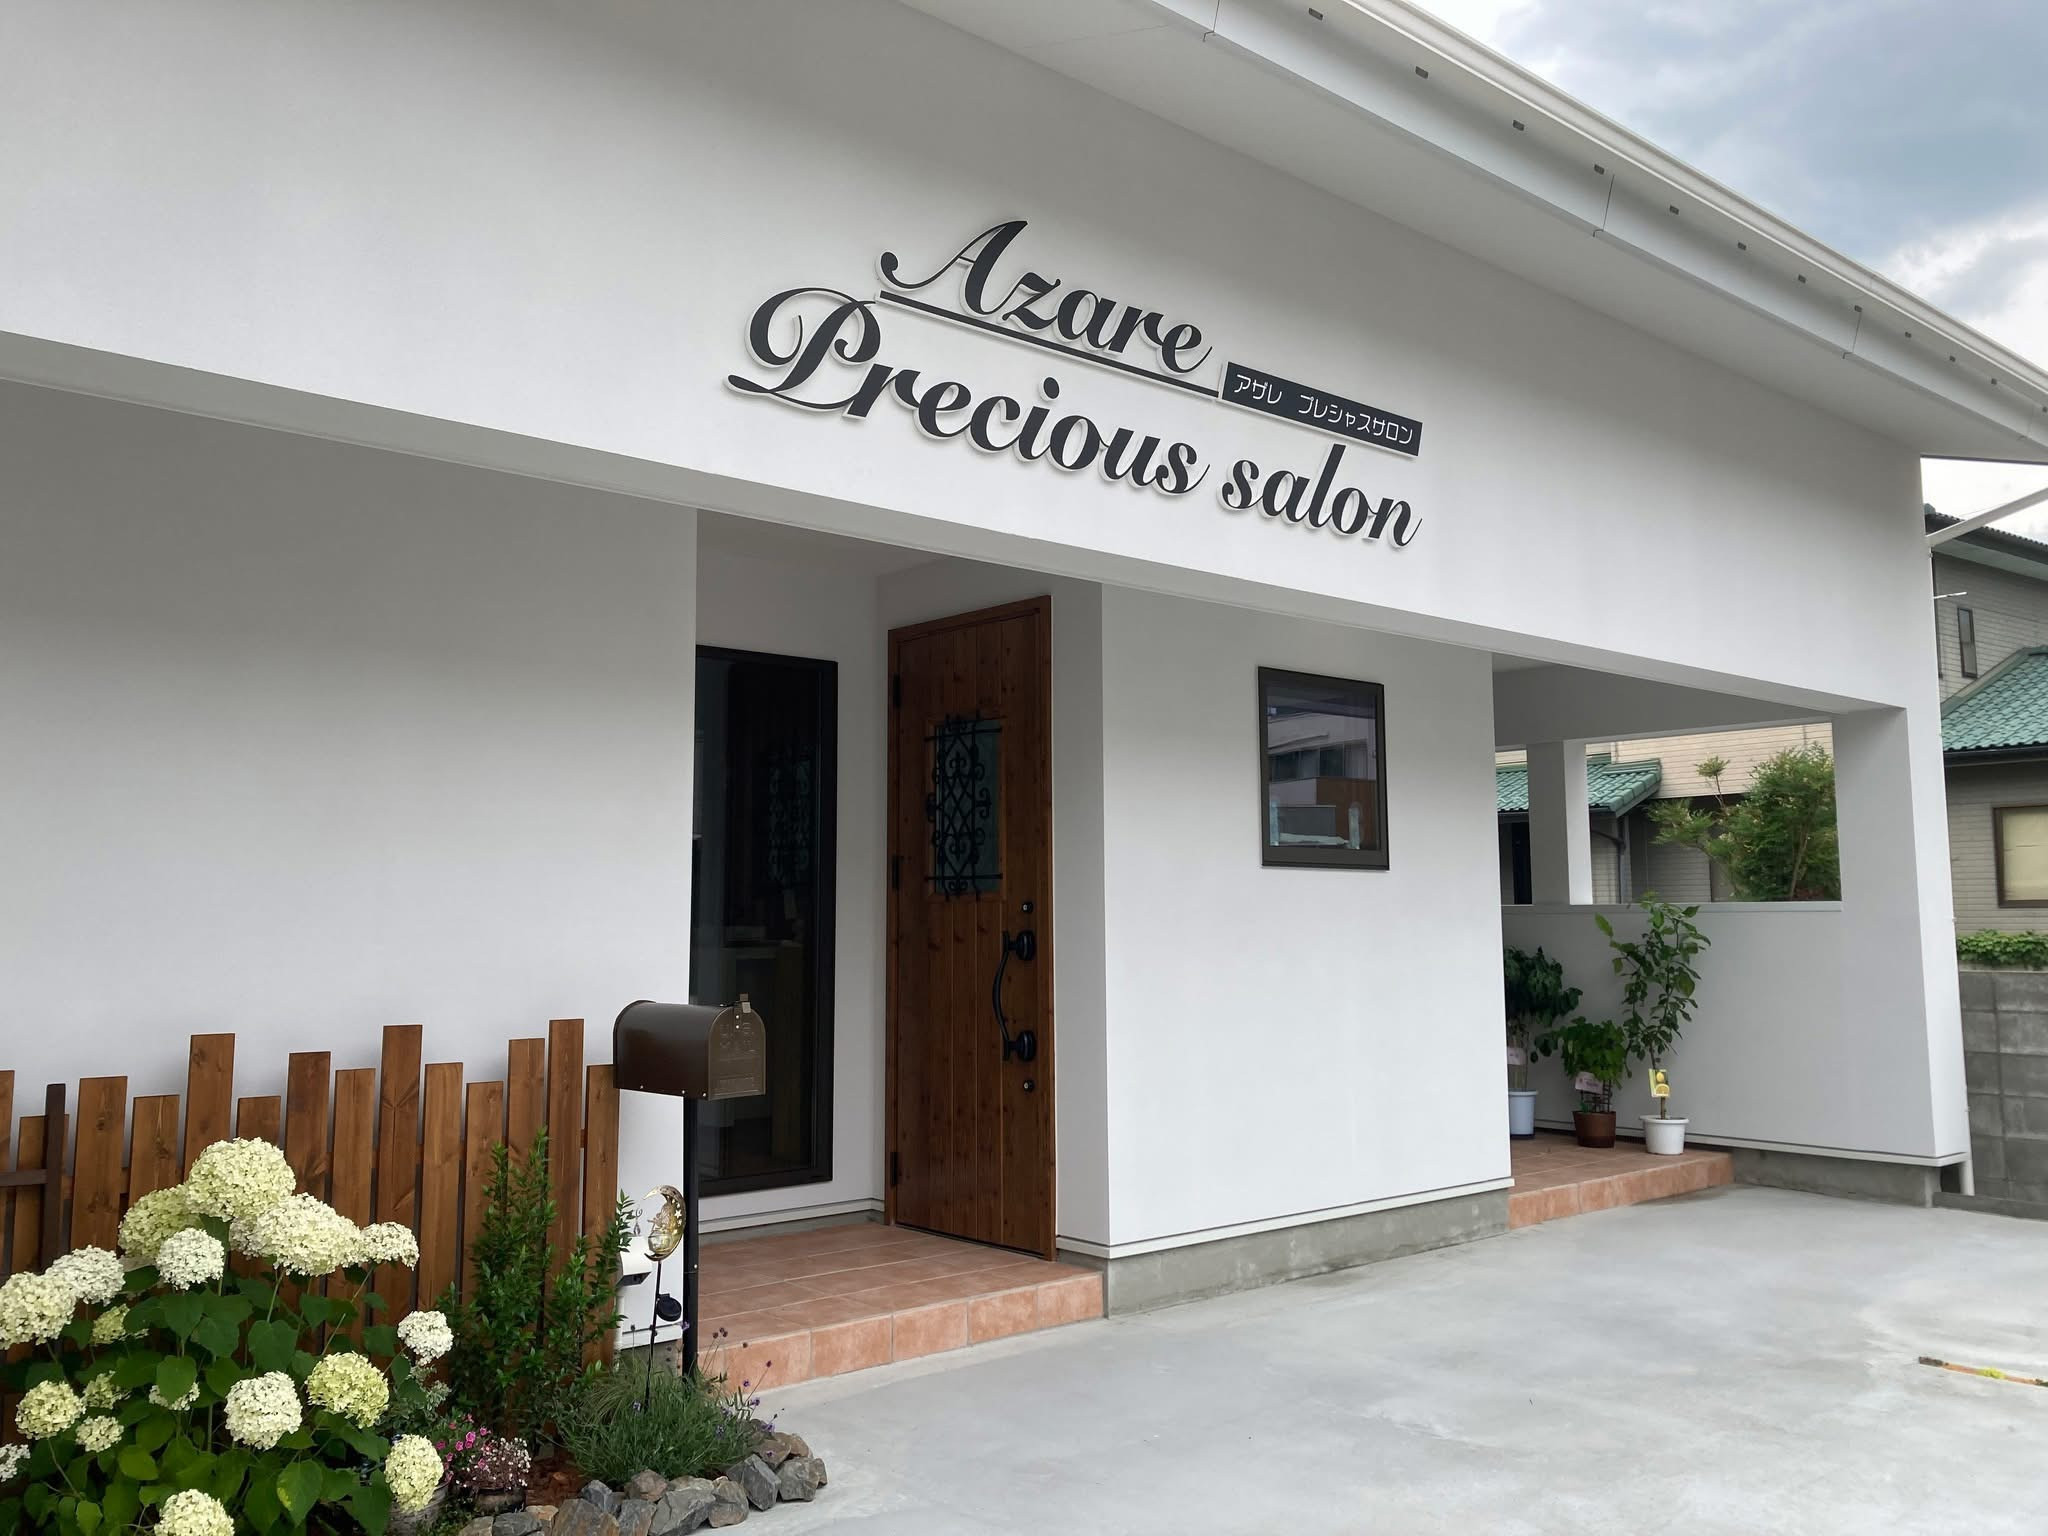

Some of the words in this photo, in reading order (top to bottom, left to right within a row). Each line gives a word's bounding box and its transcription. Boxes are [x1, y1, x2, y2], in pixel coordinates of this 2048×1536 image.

[880, 220, 1213, 374] Azare
[727, 287, 1211, 494] Precious
[1221, 443, 1423, 547] salon
[1233, 373, 1283, 405] アザレ
[1298, 394, 1413, 445] プレシャスサロン
